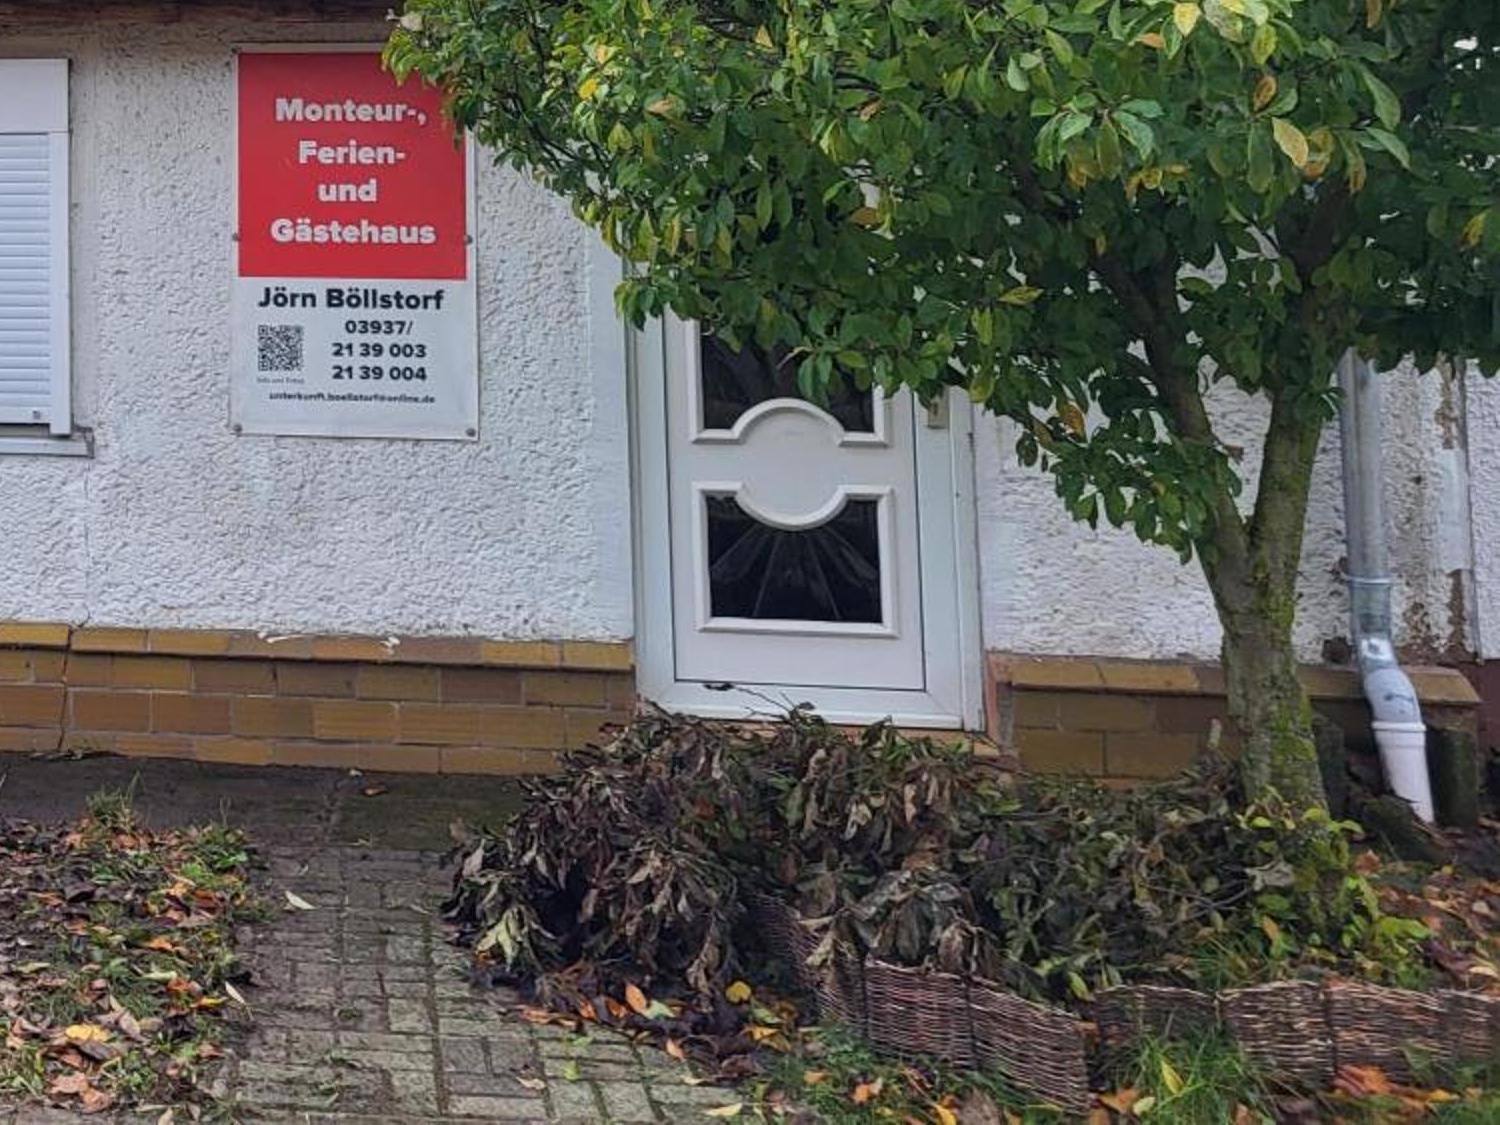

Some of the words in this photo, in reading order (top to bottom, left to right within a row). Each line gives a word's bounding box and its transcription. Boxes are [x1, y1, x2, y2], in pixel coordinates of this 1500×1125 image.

[275, 98, 426, 125] Monteur-,
[298, 140, 405, 165] Ferien-
[318, 179, 378, 203] und
[270, 218, 437, 245] Gästehaus
[258, 286, 317, 308] Jörn
[326, 287, 445, 310] Böllstorf
[345, 320, 414, 335] 03937/
[332, 343, 354, 357] 21
[360, 343, 384, 357] 39
[389, 343, 428, 358] 003
[332, 365, 354, 380] 21
[360, 366, 384, 380] 39
[389, 366, 428, 381] 004
